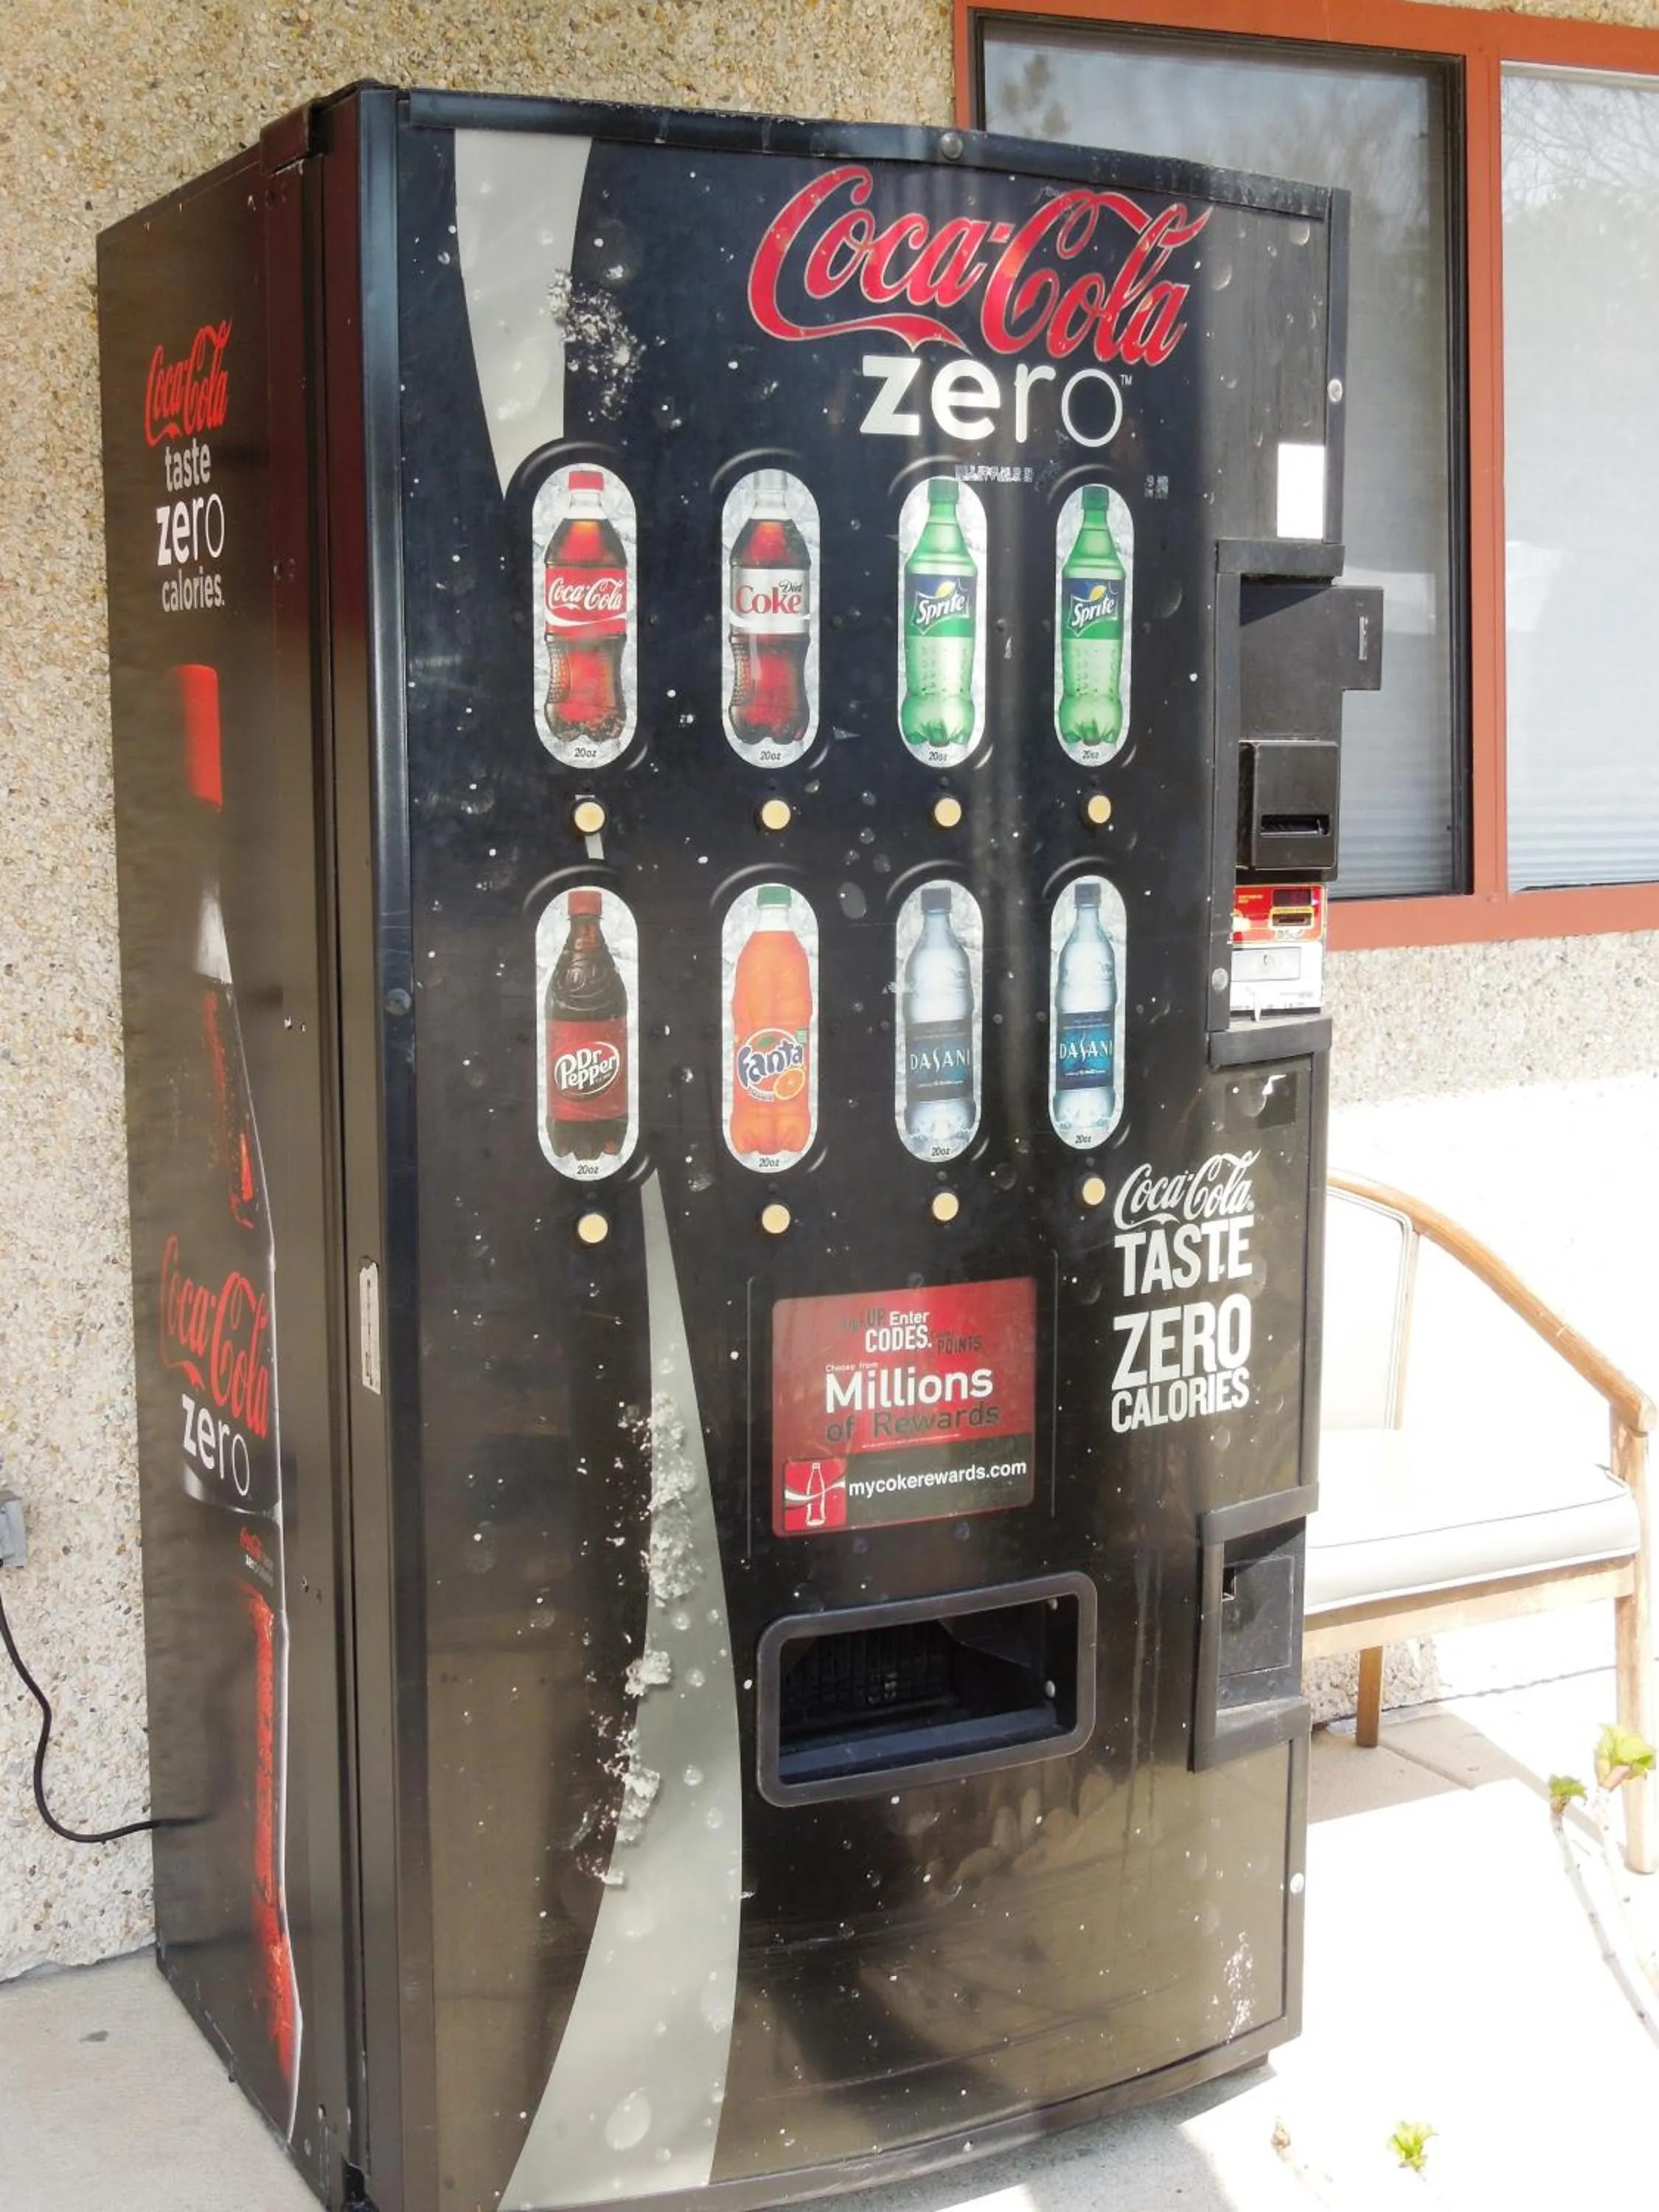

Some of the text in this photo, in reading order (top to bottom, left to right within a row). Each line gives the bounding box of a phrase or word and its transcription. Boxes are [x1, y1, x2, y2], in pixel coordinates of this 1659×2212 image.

[748, 164, 1214, 366] Coca-Cola
[145, 318, 232, 448] Coca-Cola
[860, 354, 1123, 448] zero
[164, 438, 212, 492] taste
[156, 493, 225, 566] zero
[549, 577, 625, 611] Coca-Cola
[736, 585, 802, 614] Coke
[779, 579, 802, 592] Diet
[917, 593, 966, 625] Sprite
[1071, 596, 1116, 627] Sprite
[576, 1048, 602, 1070] Dr
[738, 1039, 804, 1089] Fanta
[910, 1048, 970, 1072] DASANI
[1060, 1032, 1113, 1062] DASANI
[554, 1054, 617, 1091] Pepper
[1114, 1214, 1253, 1297] TASTE
[159, 1234, 270, 1439] Coca-Cola
[890, 1310, 931, 1326] Enter
[1111, 1293, 1252, 1391] ZERO
[825, 1366, 993, 1414] Millions
[1111, 1367, 1251, 1433] CALORIES
[826, 1402, 1001, 1443] of Rewards
[182, 1394, 250, 1496] zero
[849, 1460, 1027, 1499] mycokerewards.com
